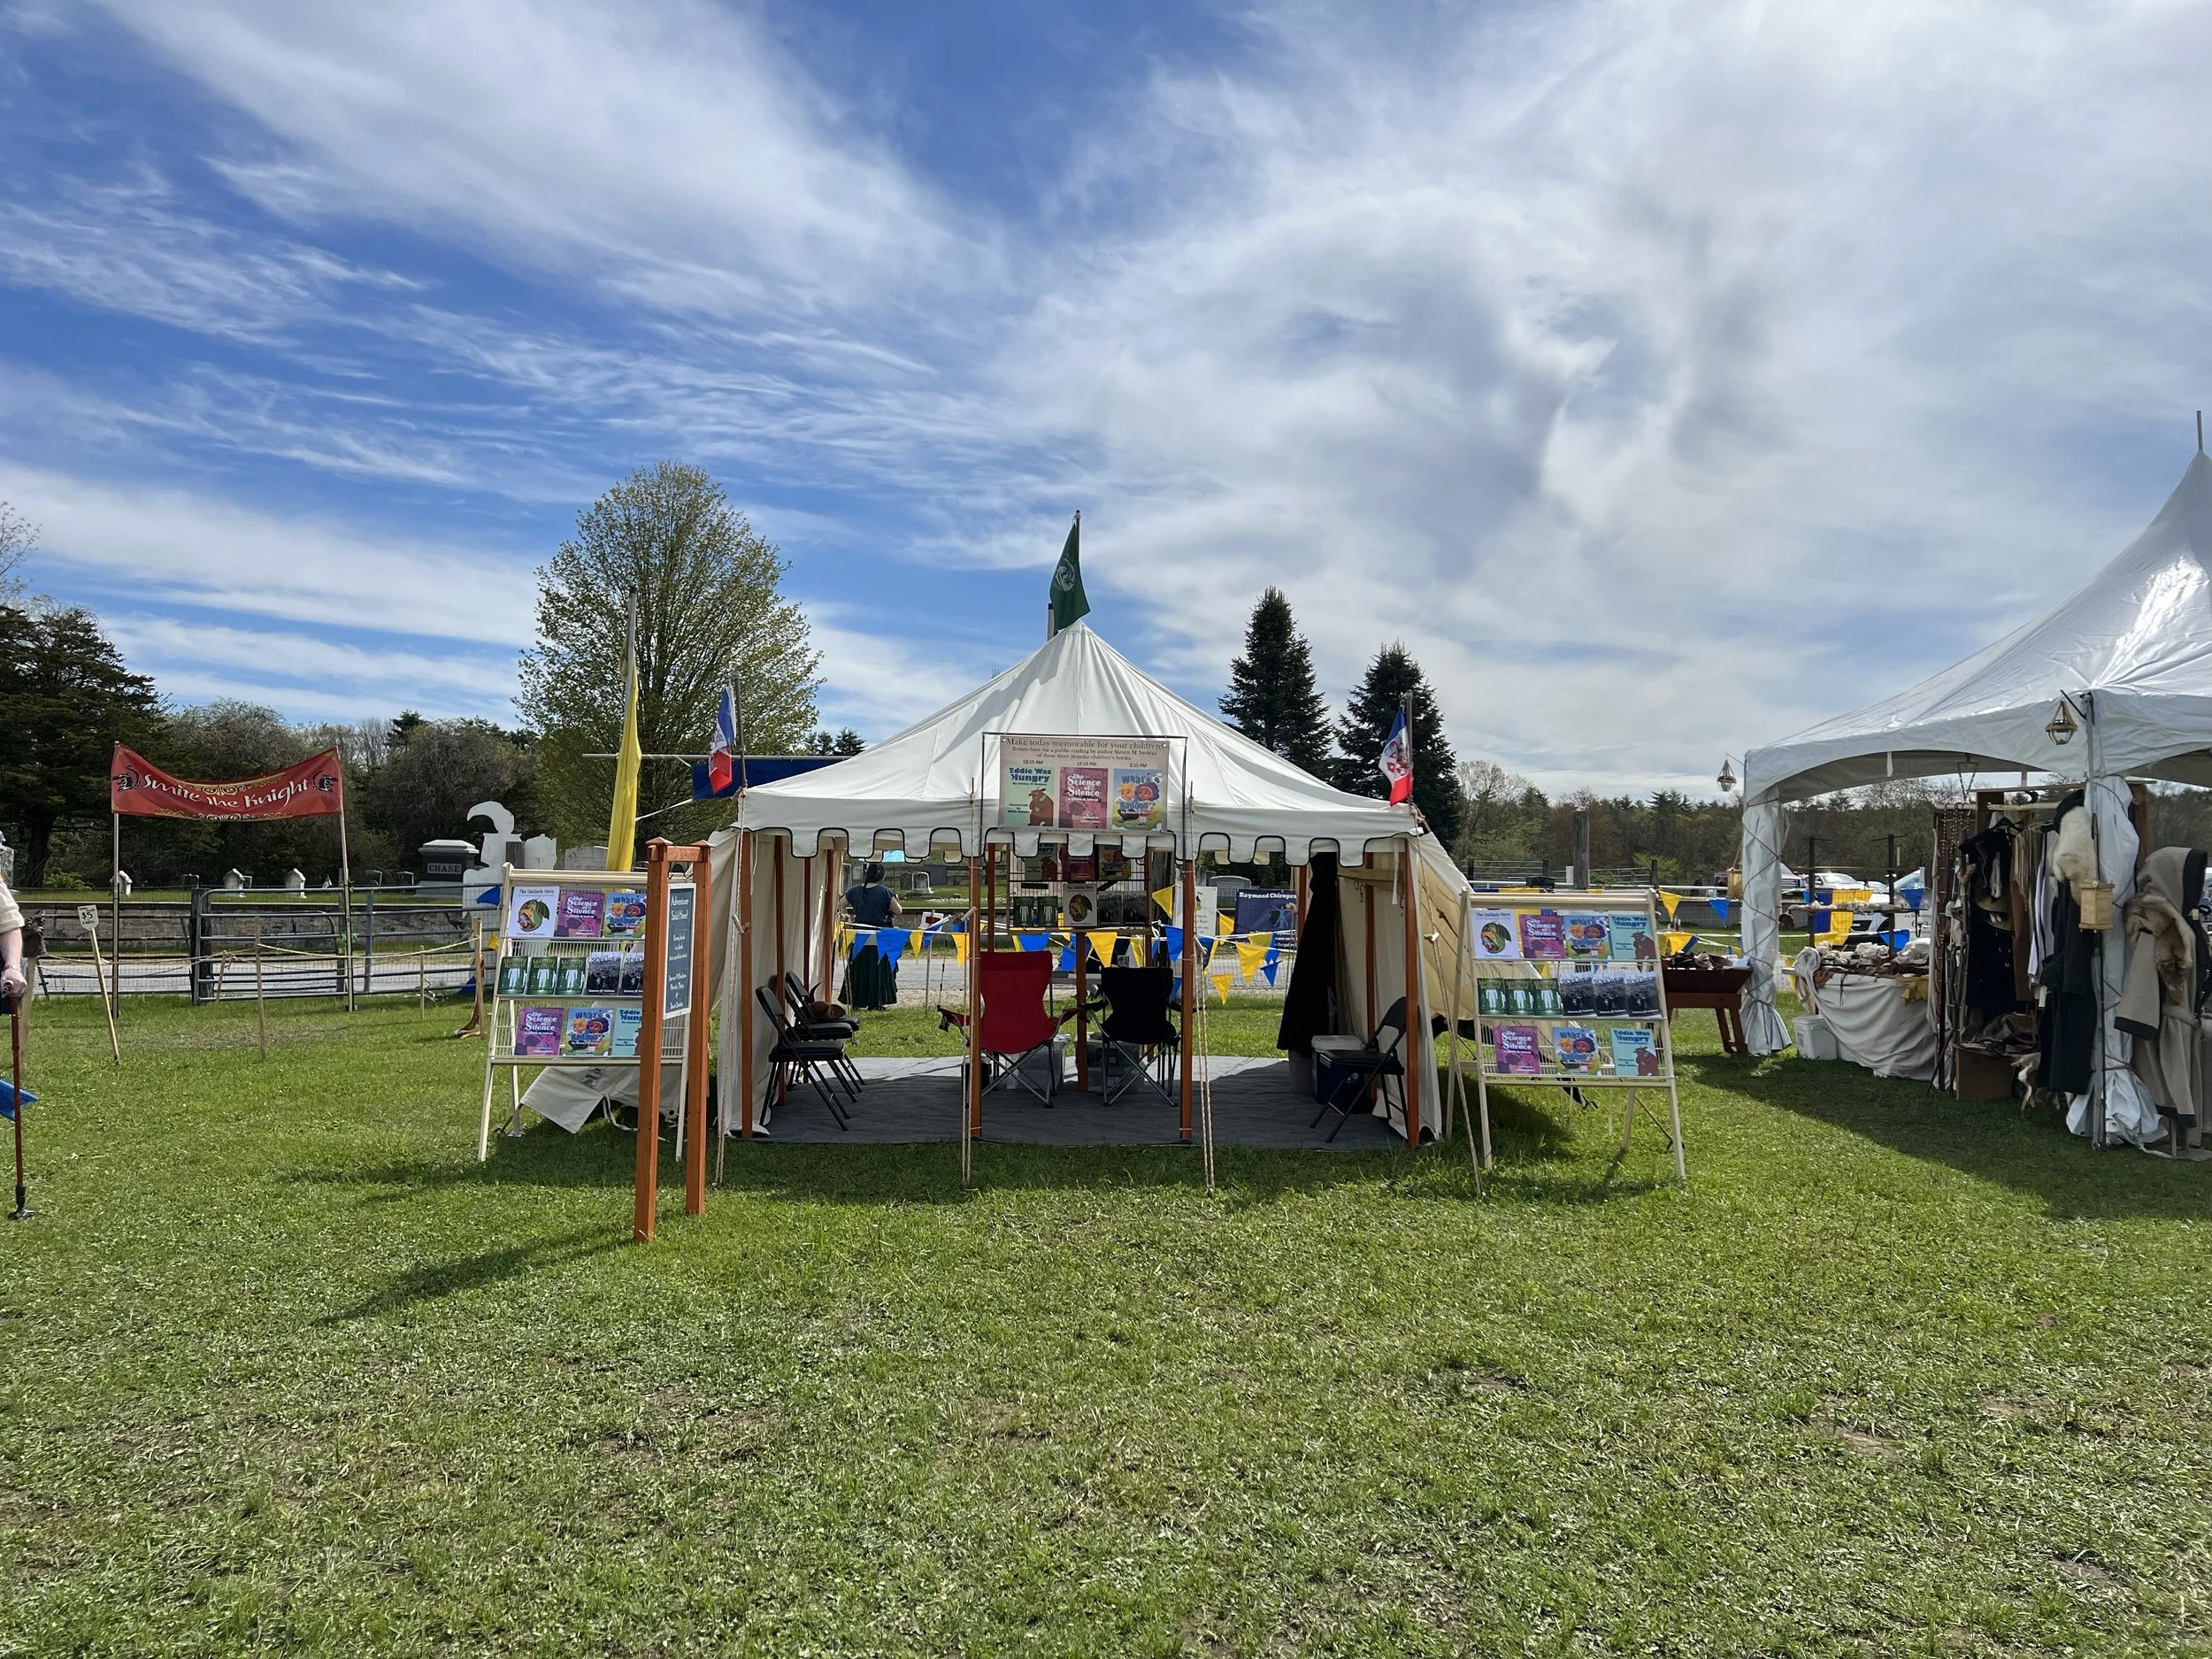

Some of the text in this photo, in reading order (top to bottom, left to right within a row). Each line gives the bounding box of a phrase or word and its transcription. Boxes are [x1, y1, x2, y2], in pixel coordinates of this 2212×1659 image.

[1030, 739, 1049, 748] today
[1052, 739, 1095, 748] memorable
[1010, 773, 1050, 783] Hungry
[1067, 775, 1102, 786] Science
[244, 779, 309, 808] Knight
[1067, 786, 1100, 796] Silence
[566, 896, 598, 907] Science
[81, 911, 93, 920] $5
[566, 906, 596, 915] Silence
[1526, 919, 1556, 929] Science
[526, 1013, 557, 1023] Science
[525, 1022, 556, 1031] Silence
[1502, 1032, 1532, 1042] Science
[1502, 1041, 1532, 1050] Silence
